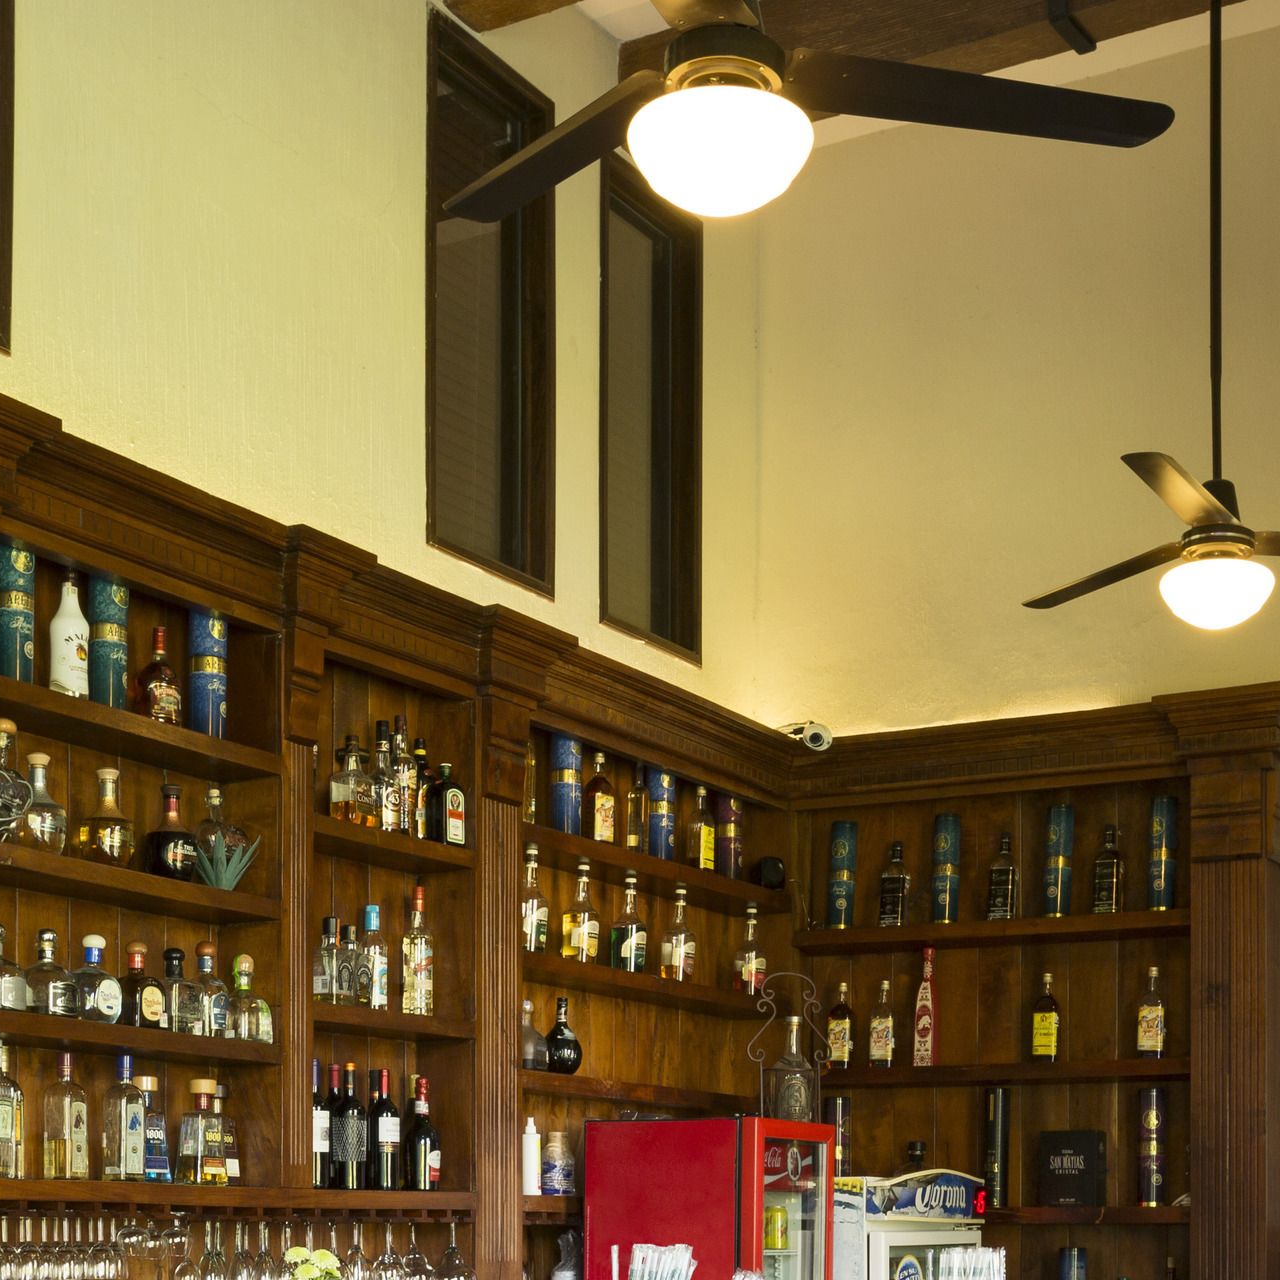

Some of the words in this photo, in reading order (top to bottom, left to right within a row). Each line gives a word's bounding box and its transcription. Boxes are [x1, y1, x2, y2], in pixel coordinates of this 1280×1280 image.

[146, 1129, 164, 1140] 1800
[205, 1131, 221, 1142] 1800
[1049, 1155, 1062, 1170] SAN
[914, 1183, 967, 1216] Corona
[900, 1270, 909, 1279] EN
